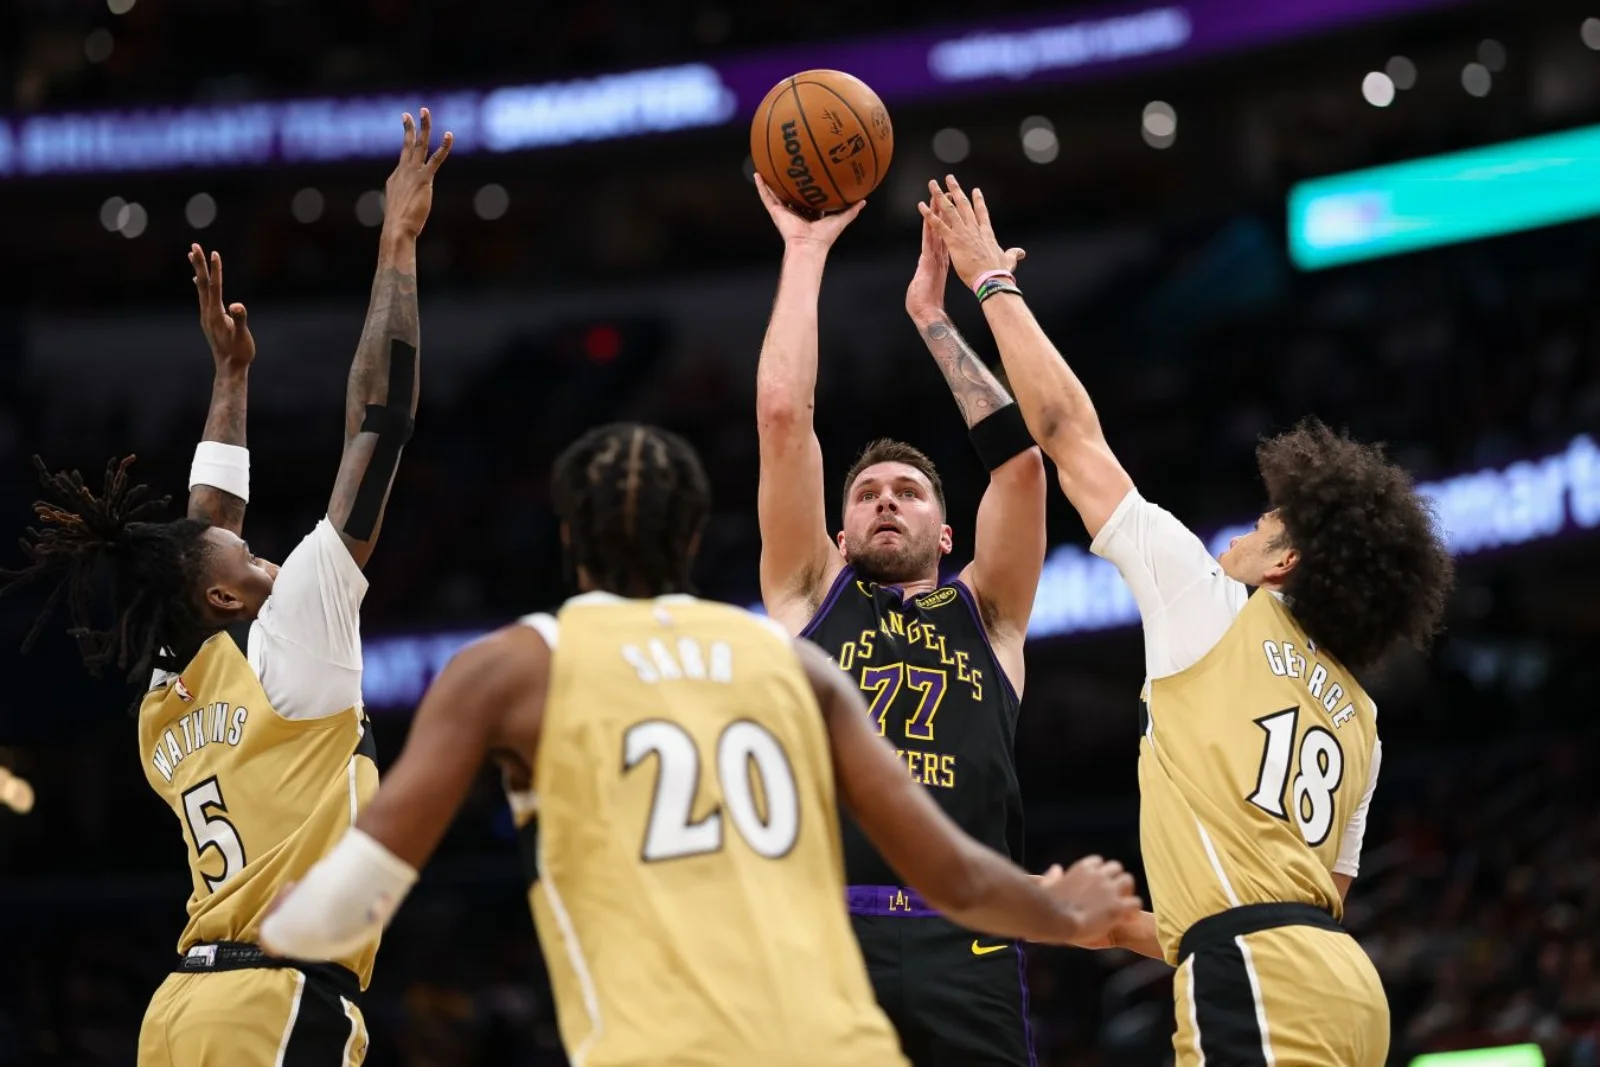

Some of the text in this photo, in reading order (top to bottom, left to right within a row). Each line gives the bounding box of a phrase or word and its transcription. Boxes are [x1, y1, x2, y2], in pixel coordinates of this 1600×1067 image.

[780, 120, 828, 207] Wilson
[827, 629, 876, 671] OS
[153, 702, 248, 783] WATKINS
[860, 661, 947, 740] 77
[621, 717, 801, 863] 20
[1245, 705, 1344, 847] 18
[181, 774, 246, 895] 5
[889, 889, 911, 911] LAL
